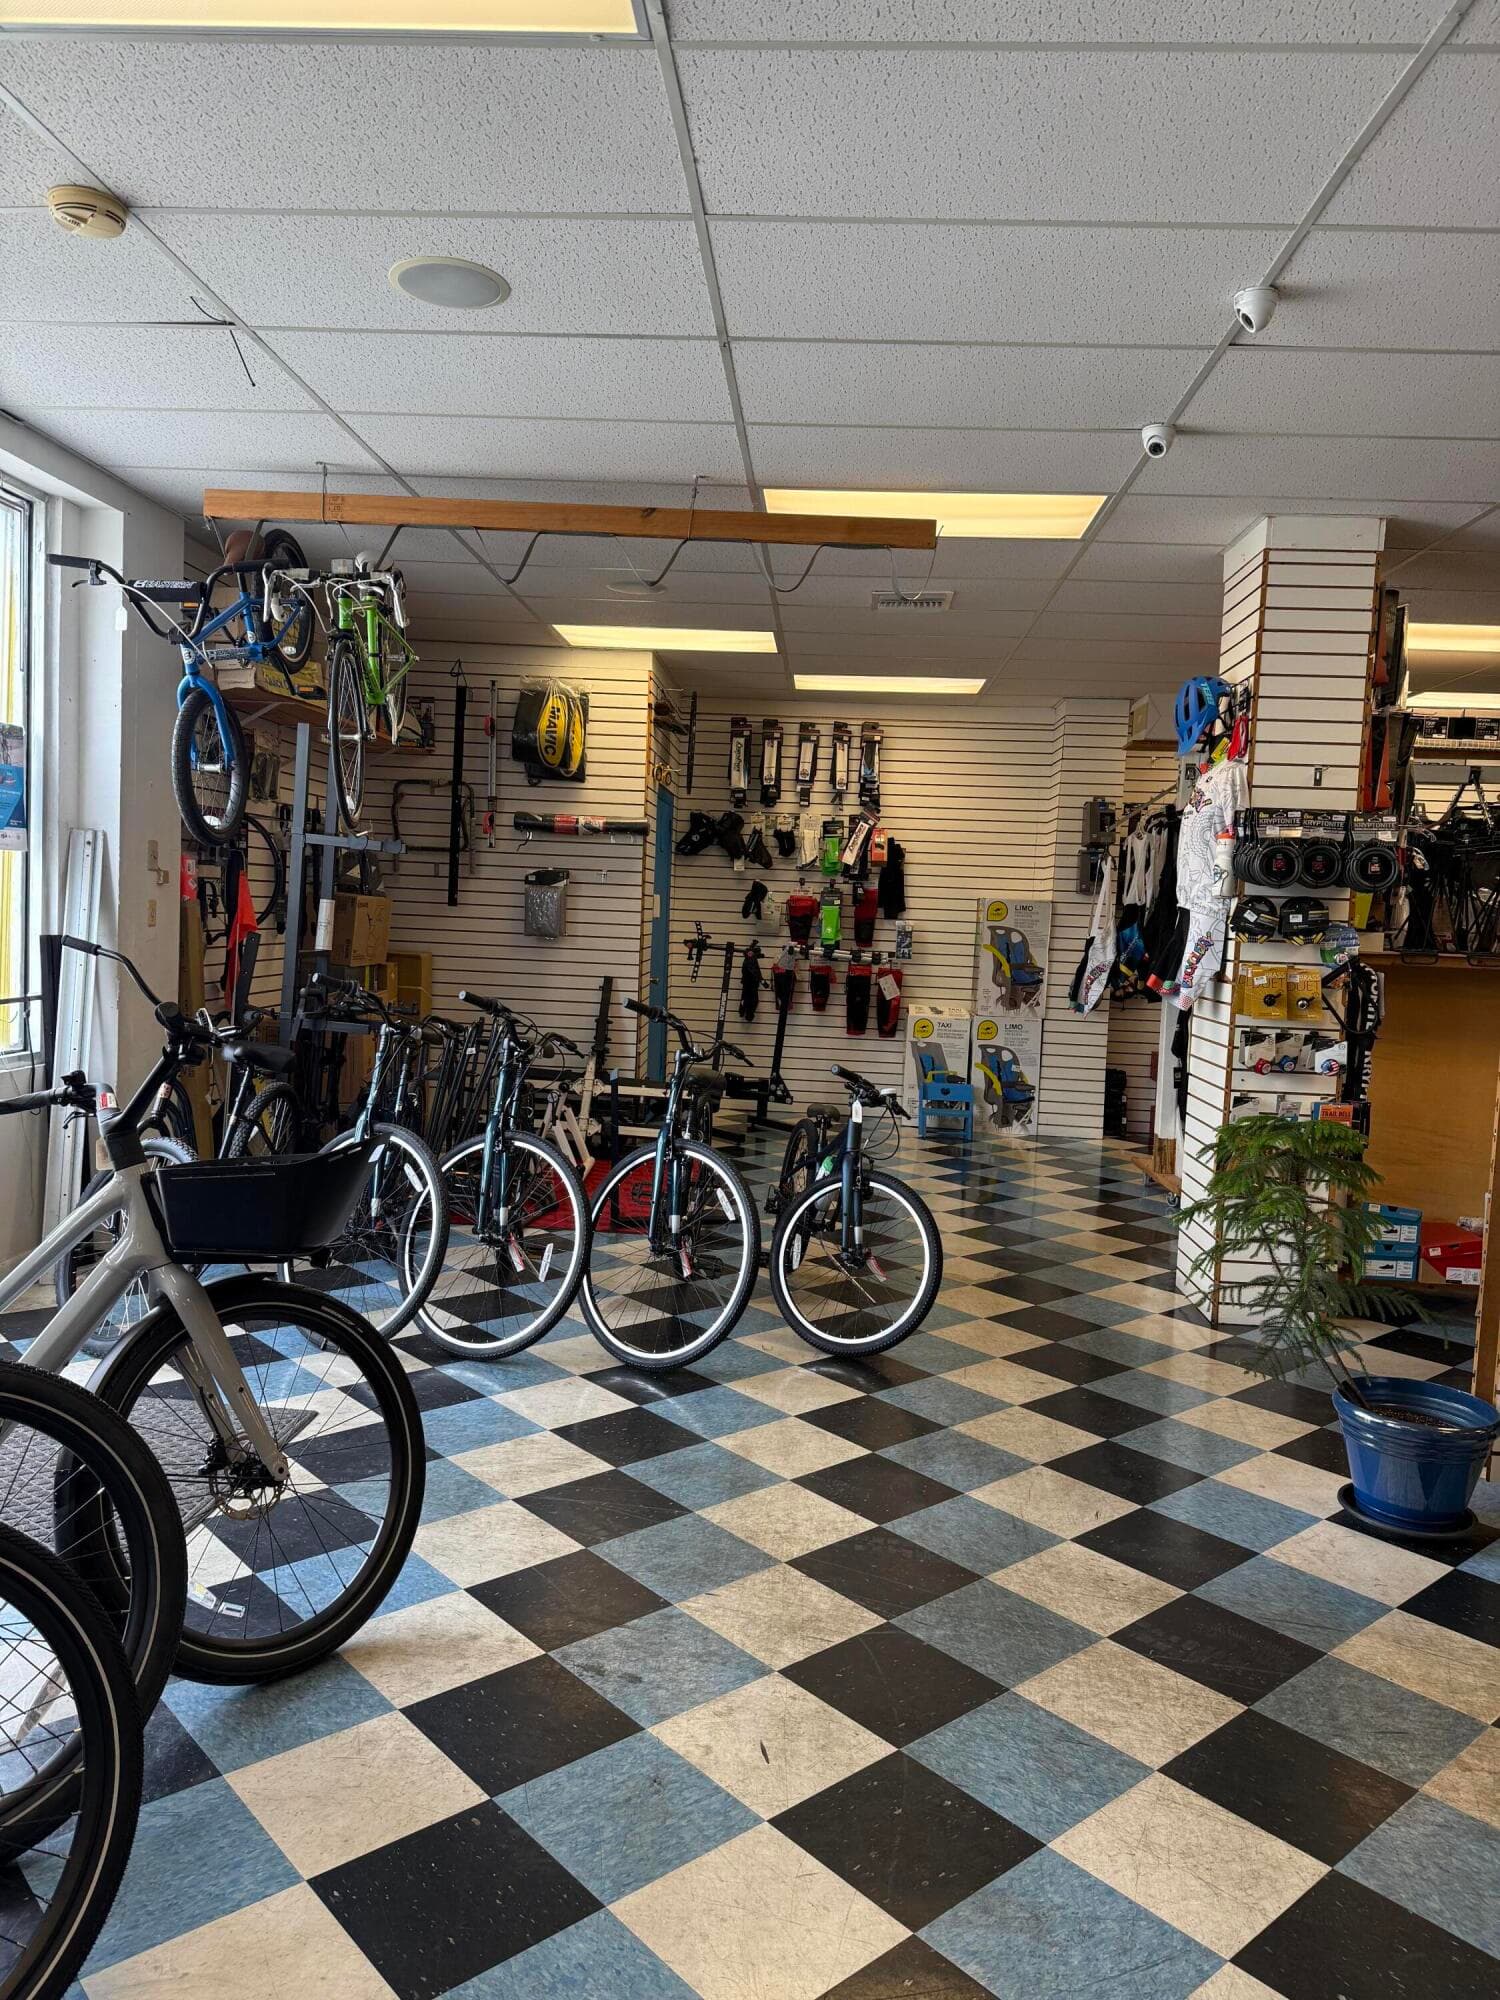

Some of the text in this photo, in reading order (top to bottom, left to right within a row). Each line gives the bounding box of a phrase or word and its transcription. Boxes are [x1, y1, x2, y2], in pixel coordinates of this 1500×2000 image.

[544, 706, 560, 756] MAVIC
[1303, 820, 1345, 828] KRYPTONITE
[937, 1021, 952, 1029] TAXI
[1004, 1023, 1024, 1031] LIMO
